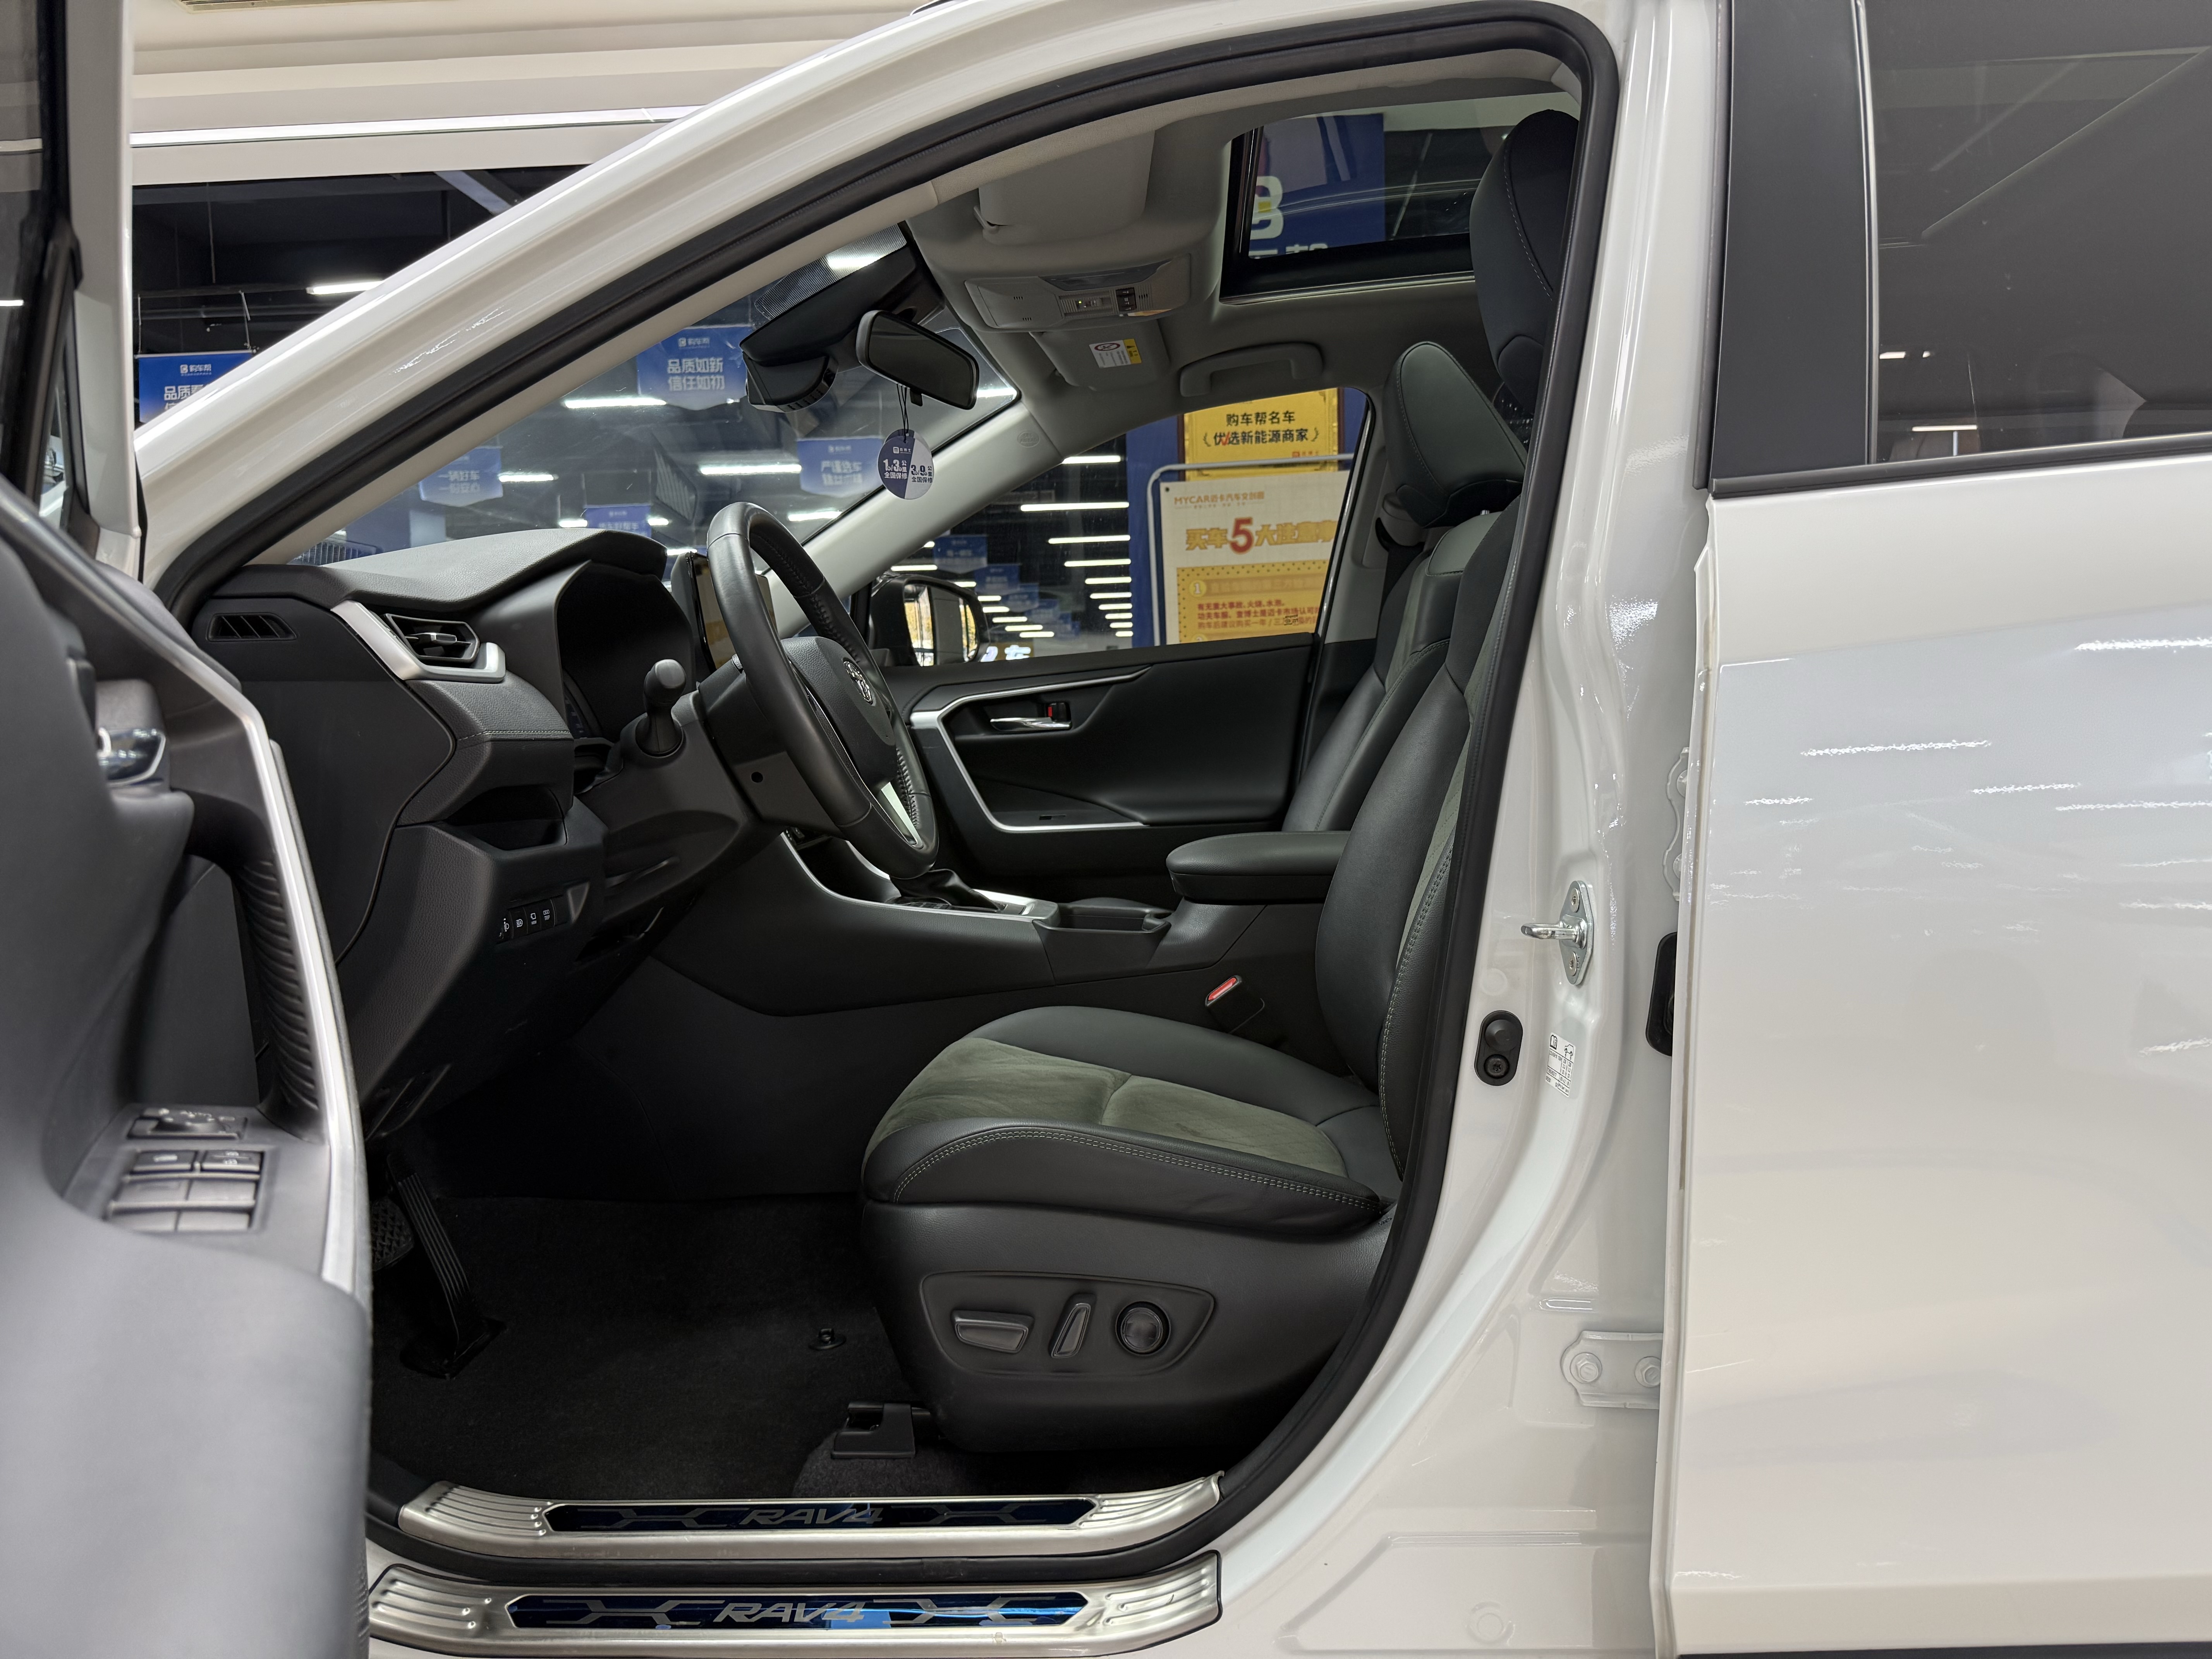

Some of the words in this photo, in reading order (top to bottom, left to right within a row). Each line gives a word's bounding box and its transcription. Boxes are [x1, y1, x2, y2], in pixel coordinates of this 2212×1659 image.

[667, 357, 724, 374] 品质如新
[668, 374, 725, 391] 信任如初
[1226, 410, 1296, 426] 购车帮名车
[1214, 428, 1308, 446] 优选新能源商家
[740, 1508, 883, 1525] RAV4
[713, 1602, 866, 1622] RAV4
